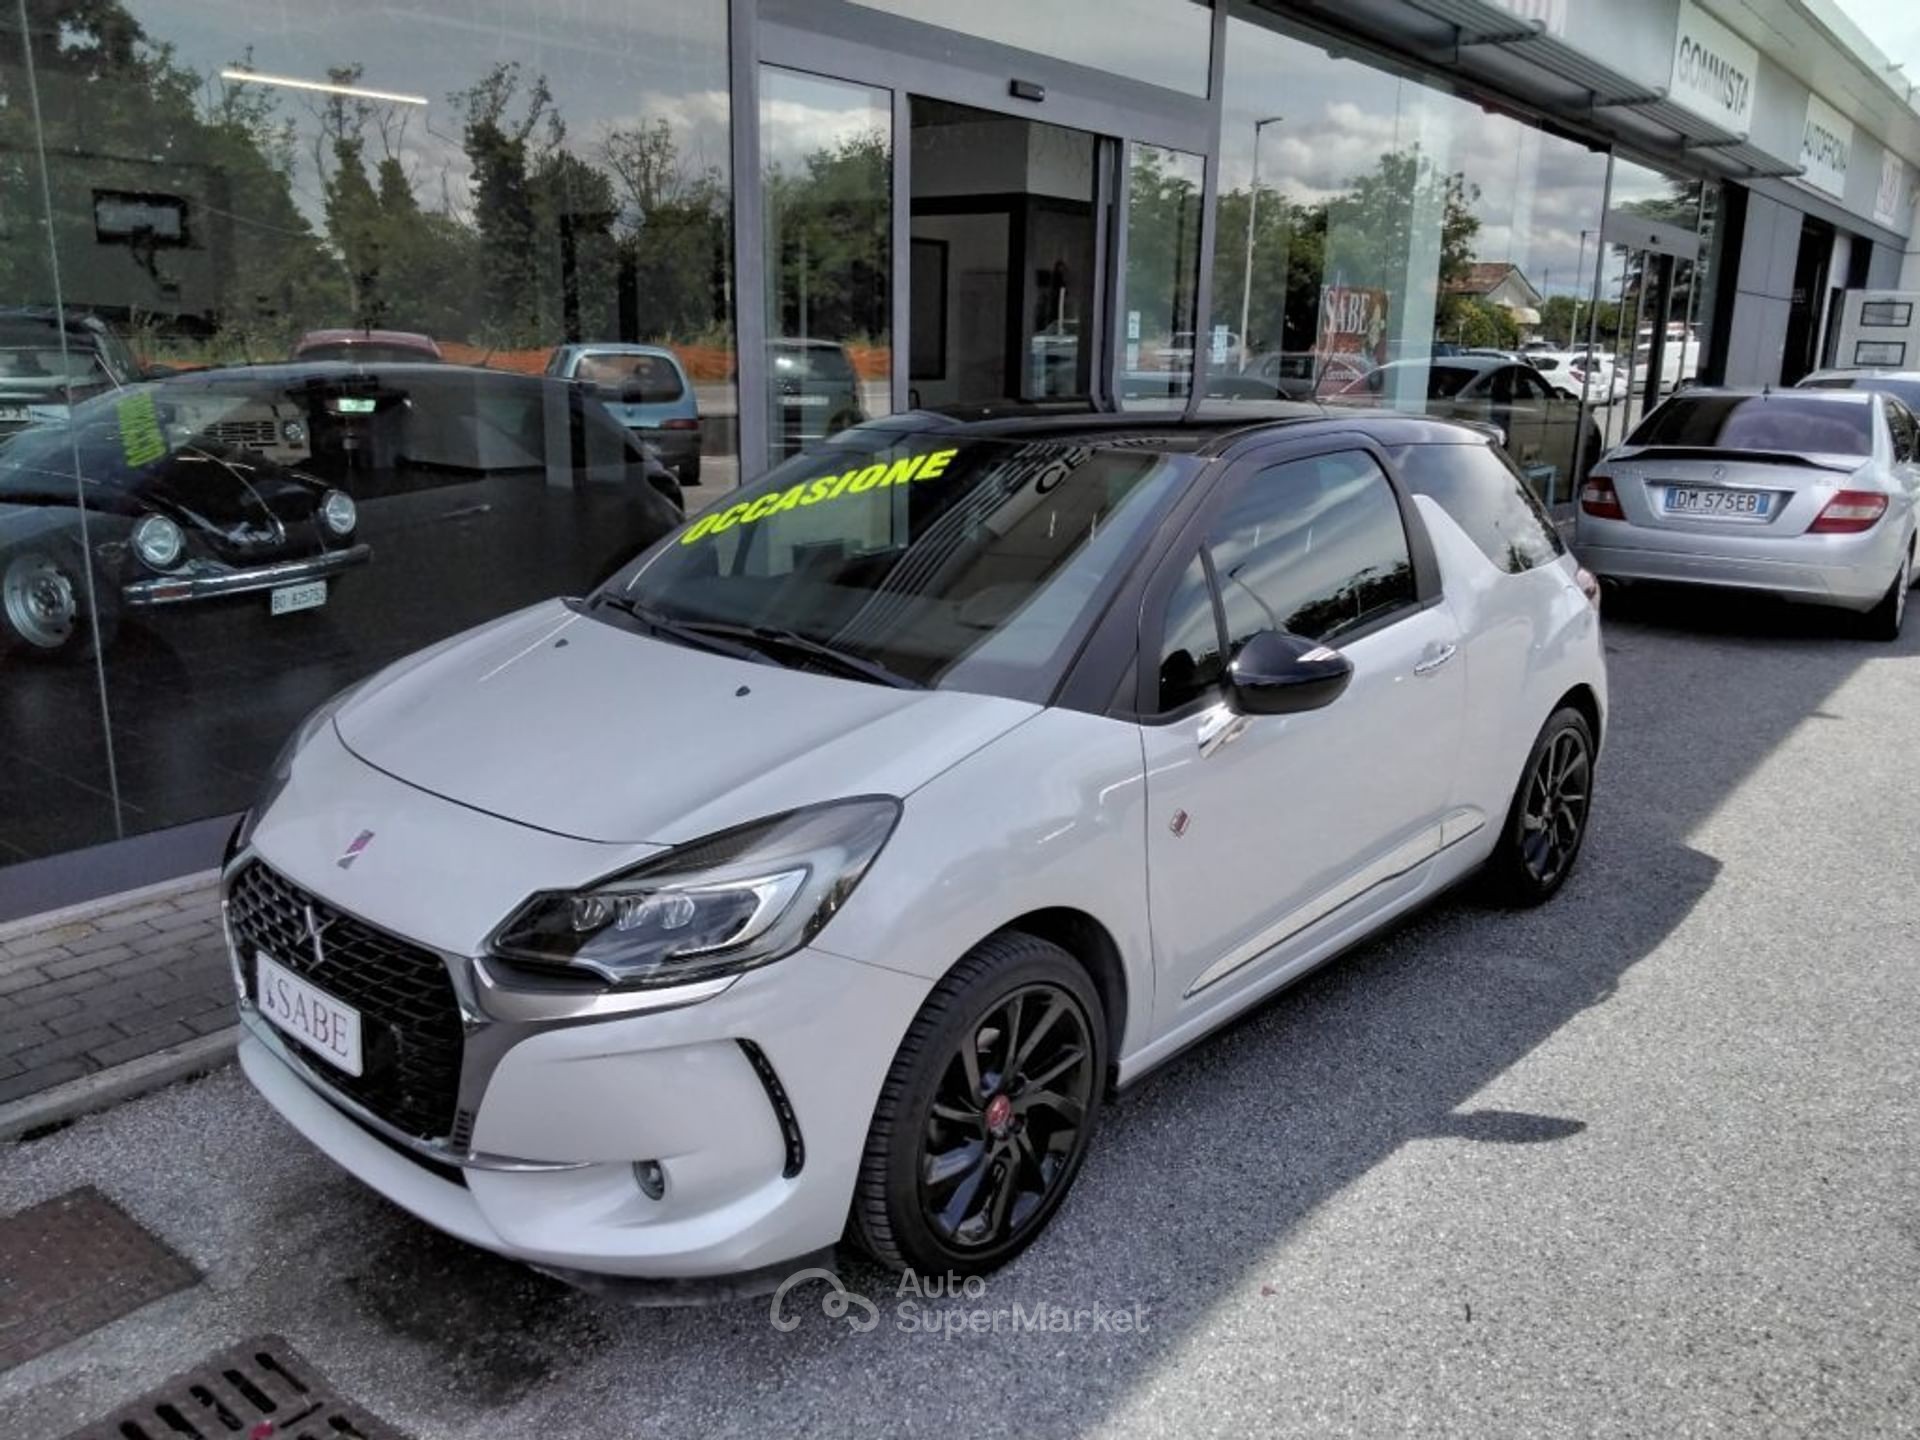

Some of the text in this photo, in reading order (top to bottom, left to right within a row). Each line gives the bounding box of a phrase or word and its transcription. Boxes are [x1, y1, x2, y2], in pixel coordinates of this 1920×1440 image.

[680, 449, 958, 545] OCCASIONE
[1678, 490, 1757, 512] DM 575EB
[277, 978, 349, 1058] SABE
